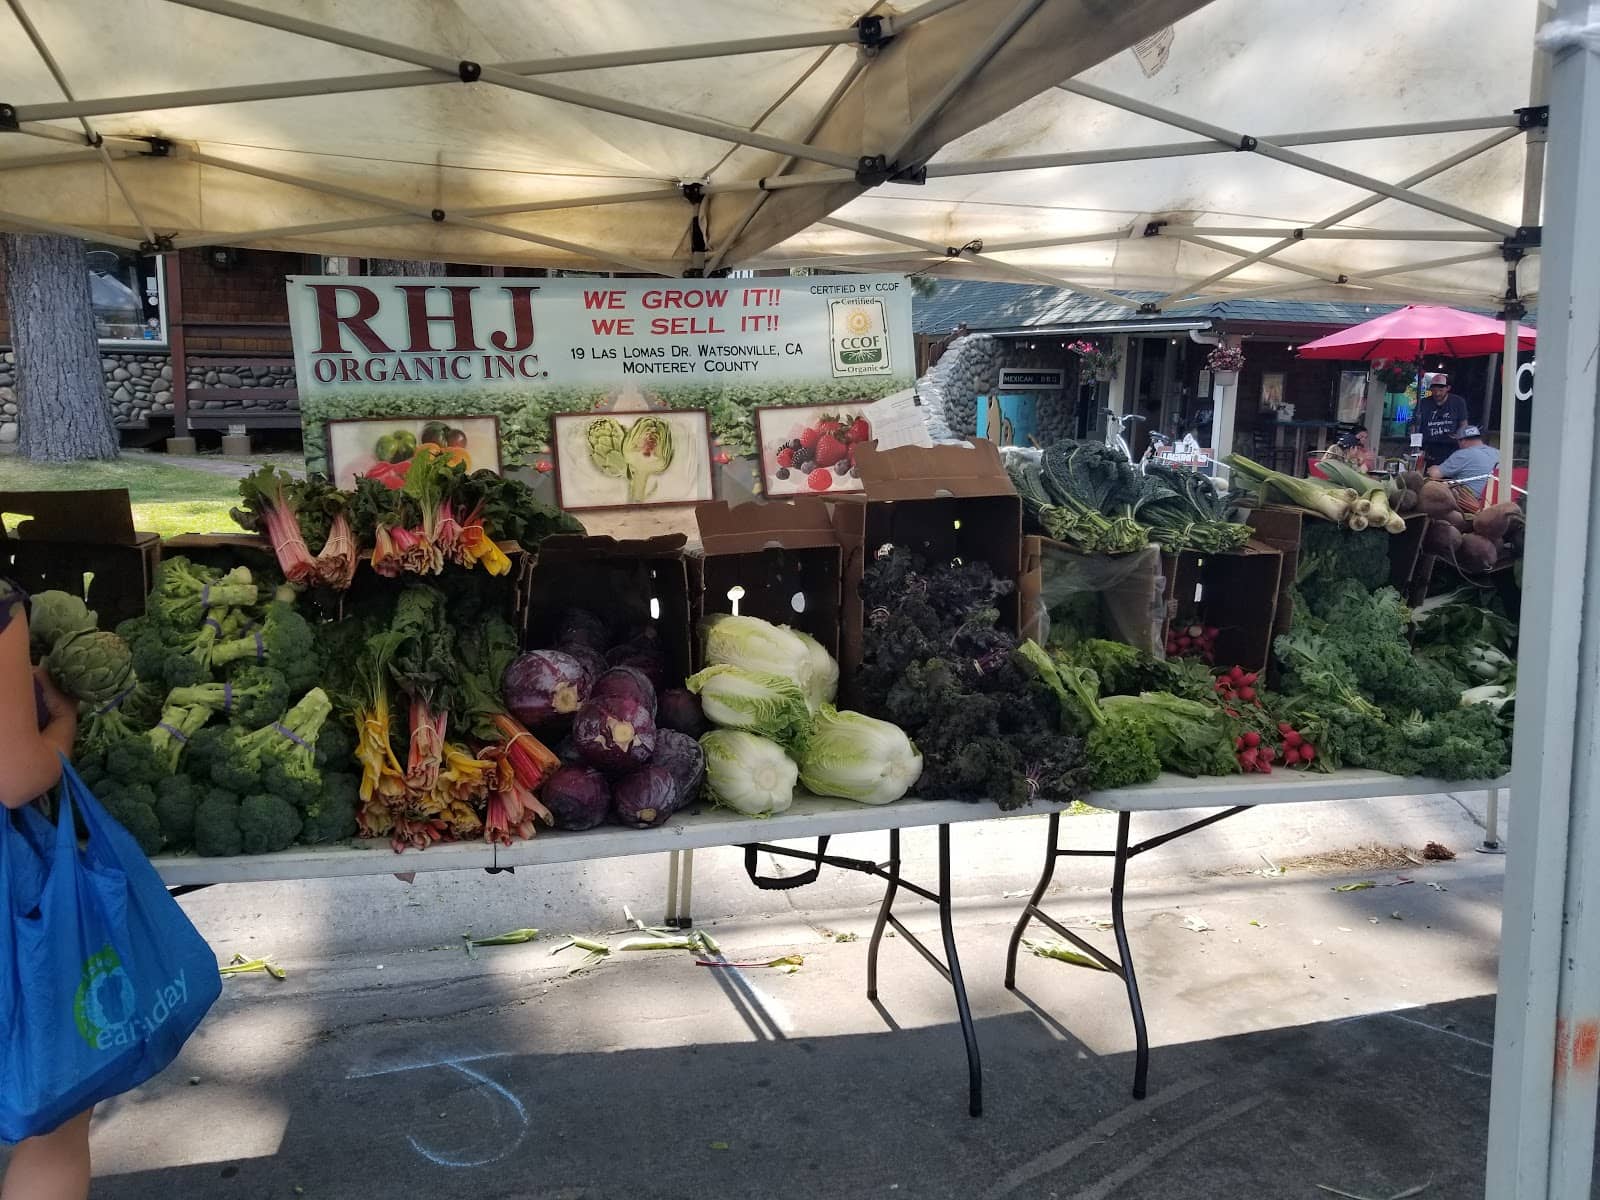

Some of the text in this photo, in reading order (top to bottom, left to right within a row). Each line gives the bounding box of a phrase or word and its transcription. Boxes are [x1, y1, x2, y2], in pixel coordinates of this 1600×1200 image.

[810, 282, 900, 295] CERTIFIED BY CCOF
[583, 288, 781, 310] WE GROW IT!!
[304, 284, 541, 354] RHJ
[591, 315, 779, 336] WE SELL IT!!
[570, 347, 585, 360] 19
[785, 342, 804, 356] CA
[840, 336, 880, 350] CCOF
[313, 354, 549, 383] ORGANIC INC.
[1003, 375, 1033, 383] MEXICAN
